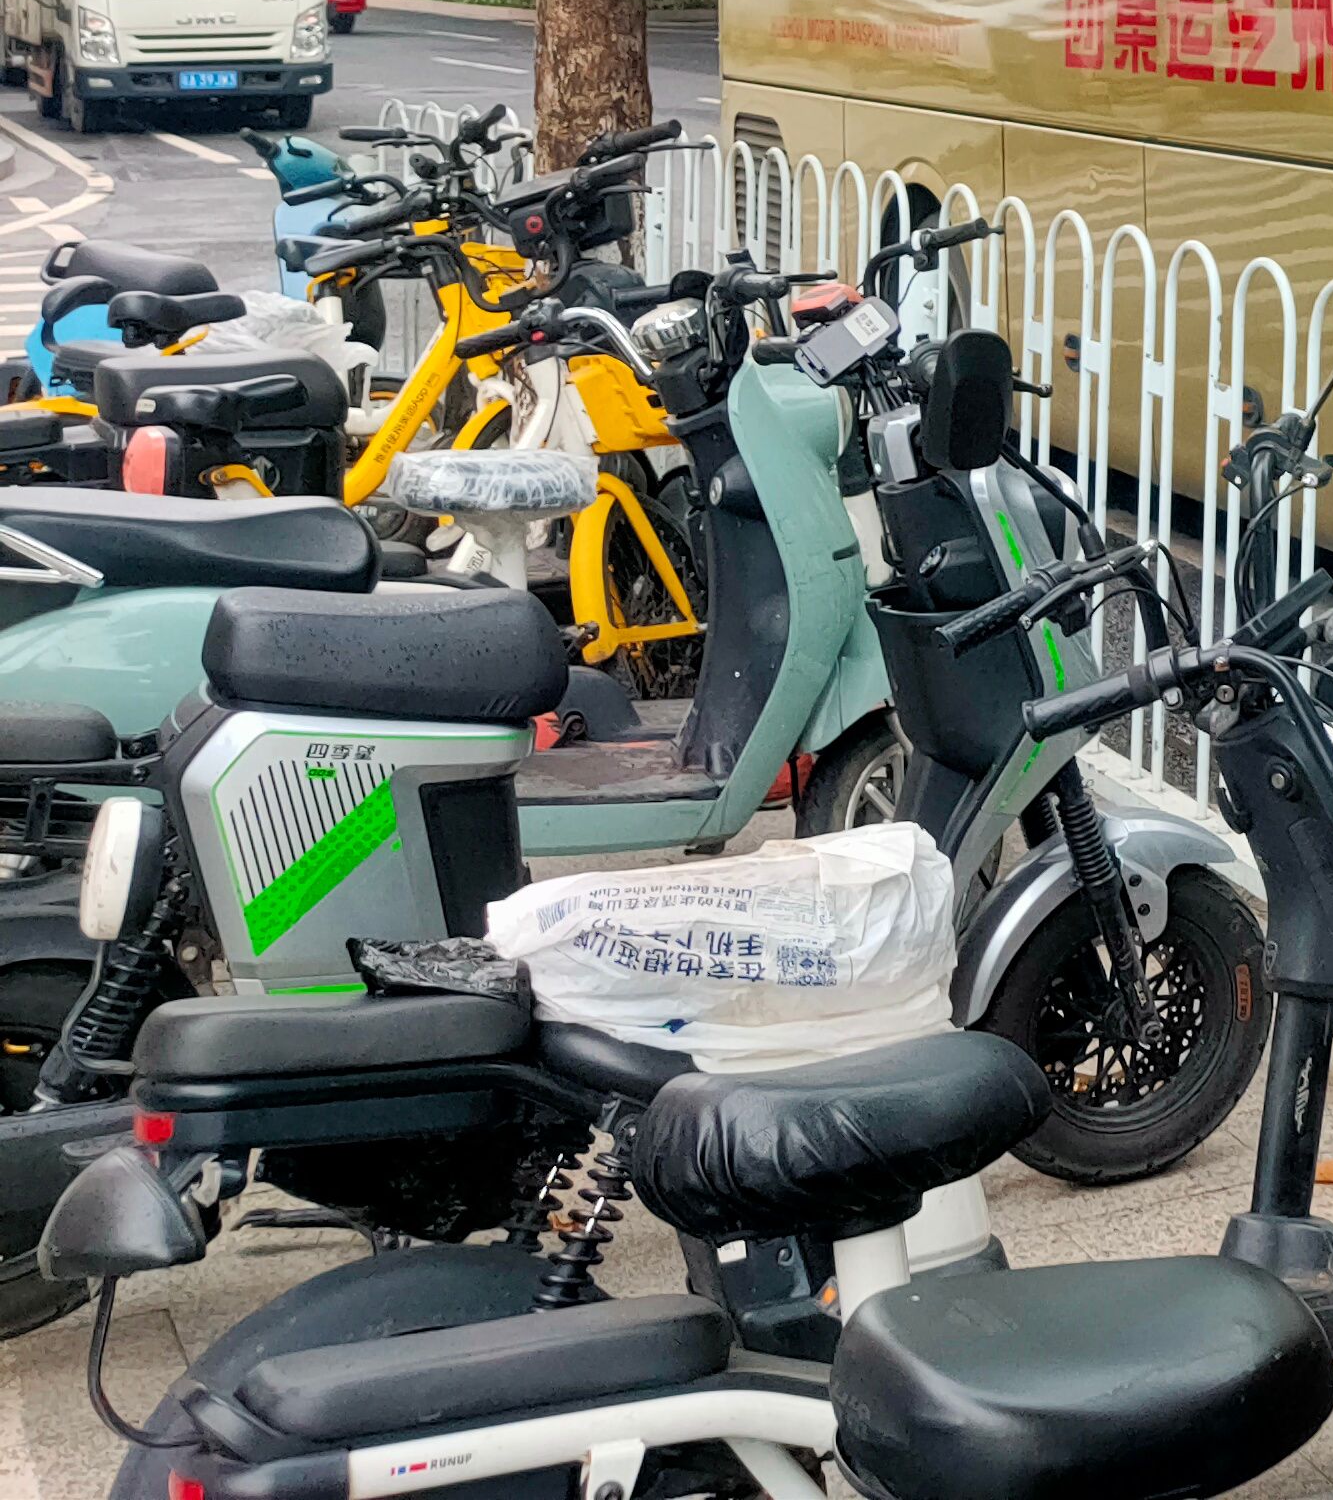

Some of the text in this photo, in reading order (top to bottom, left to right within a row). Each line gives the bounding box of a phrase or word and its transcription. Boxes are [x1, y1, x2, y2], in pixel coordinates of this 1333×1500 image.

[176, 14, 237, 26] JMC
[588, 884, 753, 899] Life is Better in the Club
[430, 1452, 473, 1471] RUNUP
